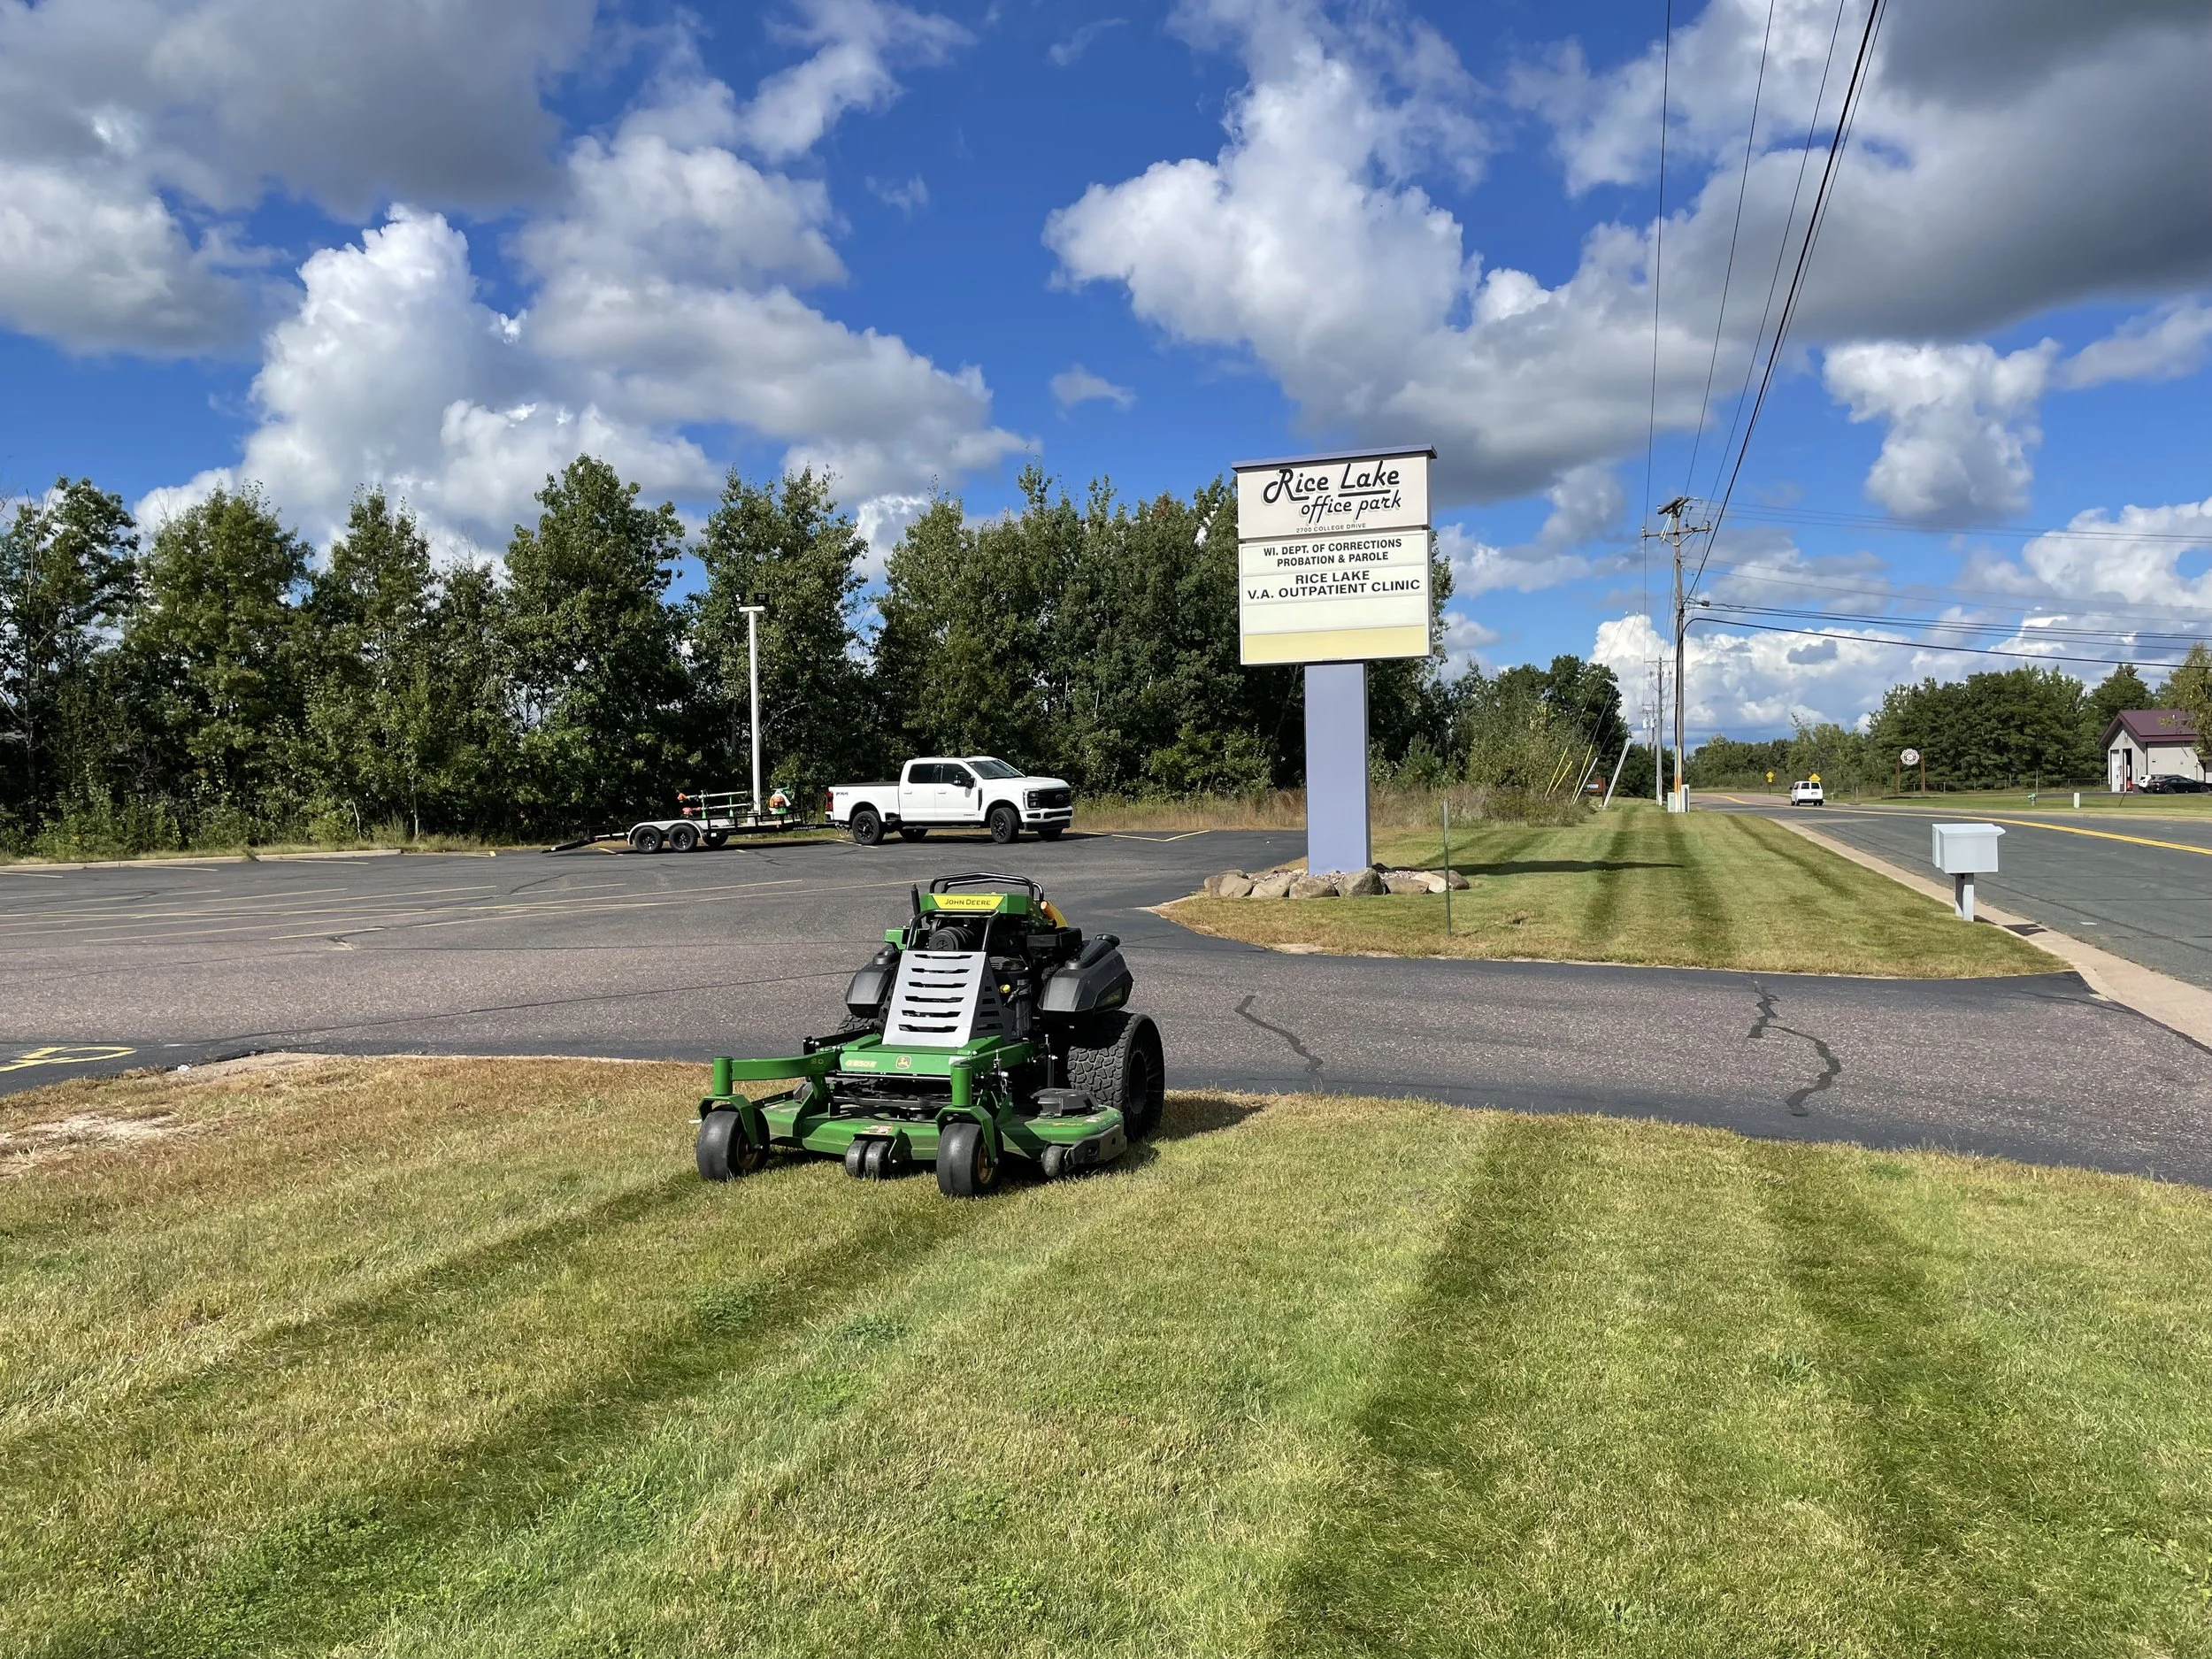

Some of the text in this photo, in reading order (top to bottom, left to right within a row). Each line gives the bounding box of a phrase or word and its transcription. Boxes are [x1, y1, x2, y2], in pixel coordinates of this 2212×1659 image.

[1263, 460, 1400, 503] Rice Lake
[1301, 489, 1402, 524] office park
[1263, 538, 1402, 557] WI. DEPT. OF CORRECTIONS
[1277, 551, 1389, 567] PROBATION & PAROLE
[1295, 570, 1370, 585] RICE LAKE
[1248, 580, 1420, 600] V.A. OUTPATIENT CLINIC
